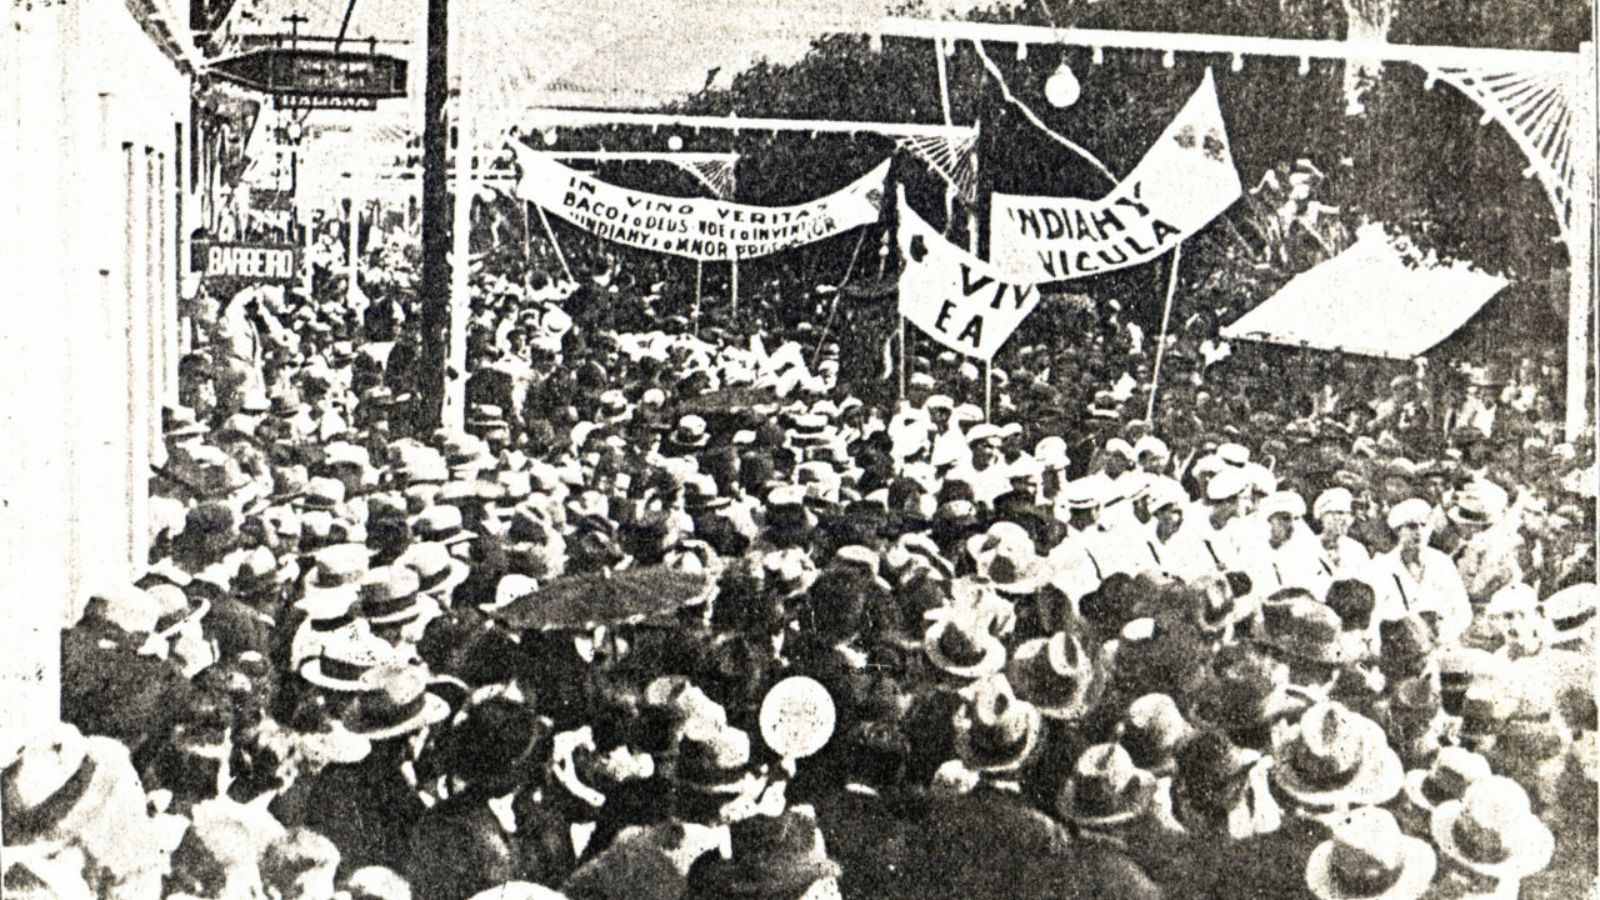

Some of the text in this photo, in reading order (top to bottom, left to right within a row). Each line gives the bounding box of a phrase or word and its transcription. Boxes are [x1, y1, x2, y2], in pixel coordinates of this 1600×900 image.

[569, 176, 596, 195] IN
[626, 196, 694, 214] VINO
[209, 247, 294, 278] BARBEIRO
